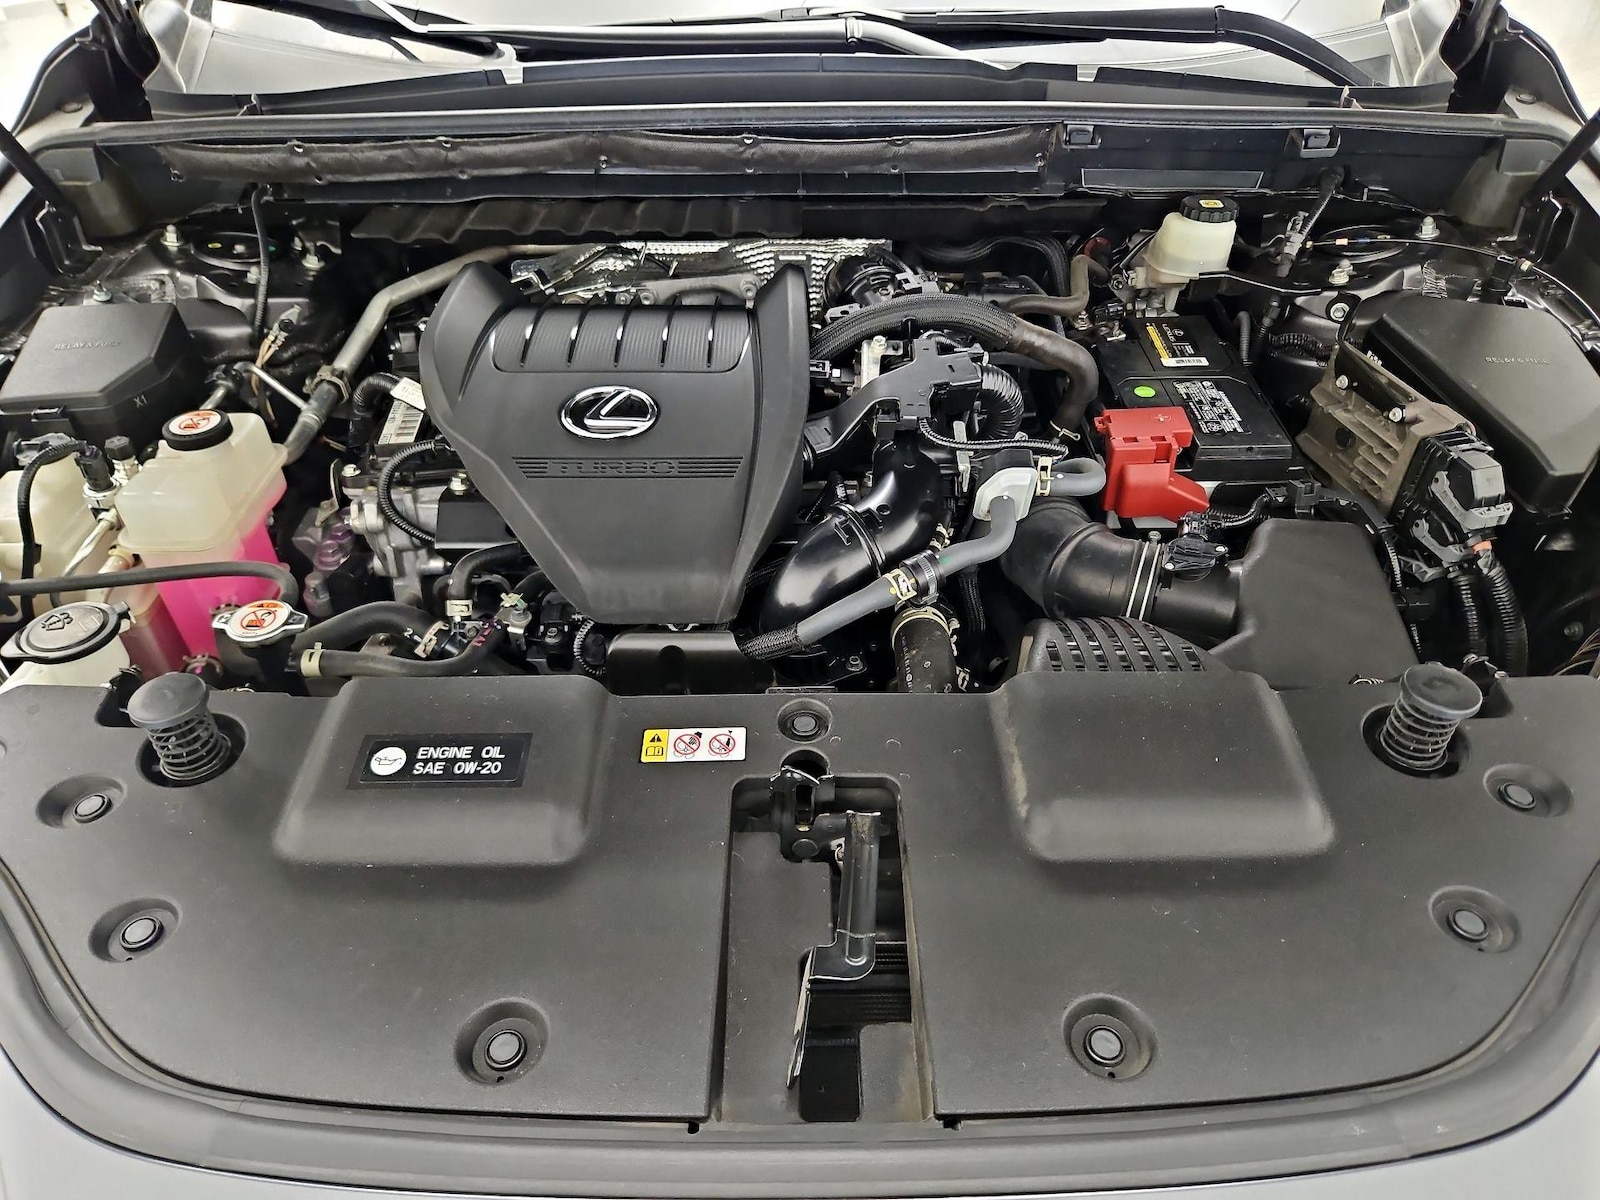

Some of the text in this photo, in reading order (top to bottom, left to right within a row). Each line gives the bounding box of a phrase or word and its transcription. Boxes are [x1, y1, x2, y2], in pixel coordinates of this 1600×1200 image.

[1162, 323, 1177, 342] LEXUS
[551, 460, 676, 475] TURBO
[416, 746, 505, 759] ENGINE OIL
[412, 761, 502, 775] SAE 0W-20
